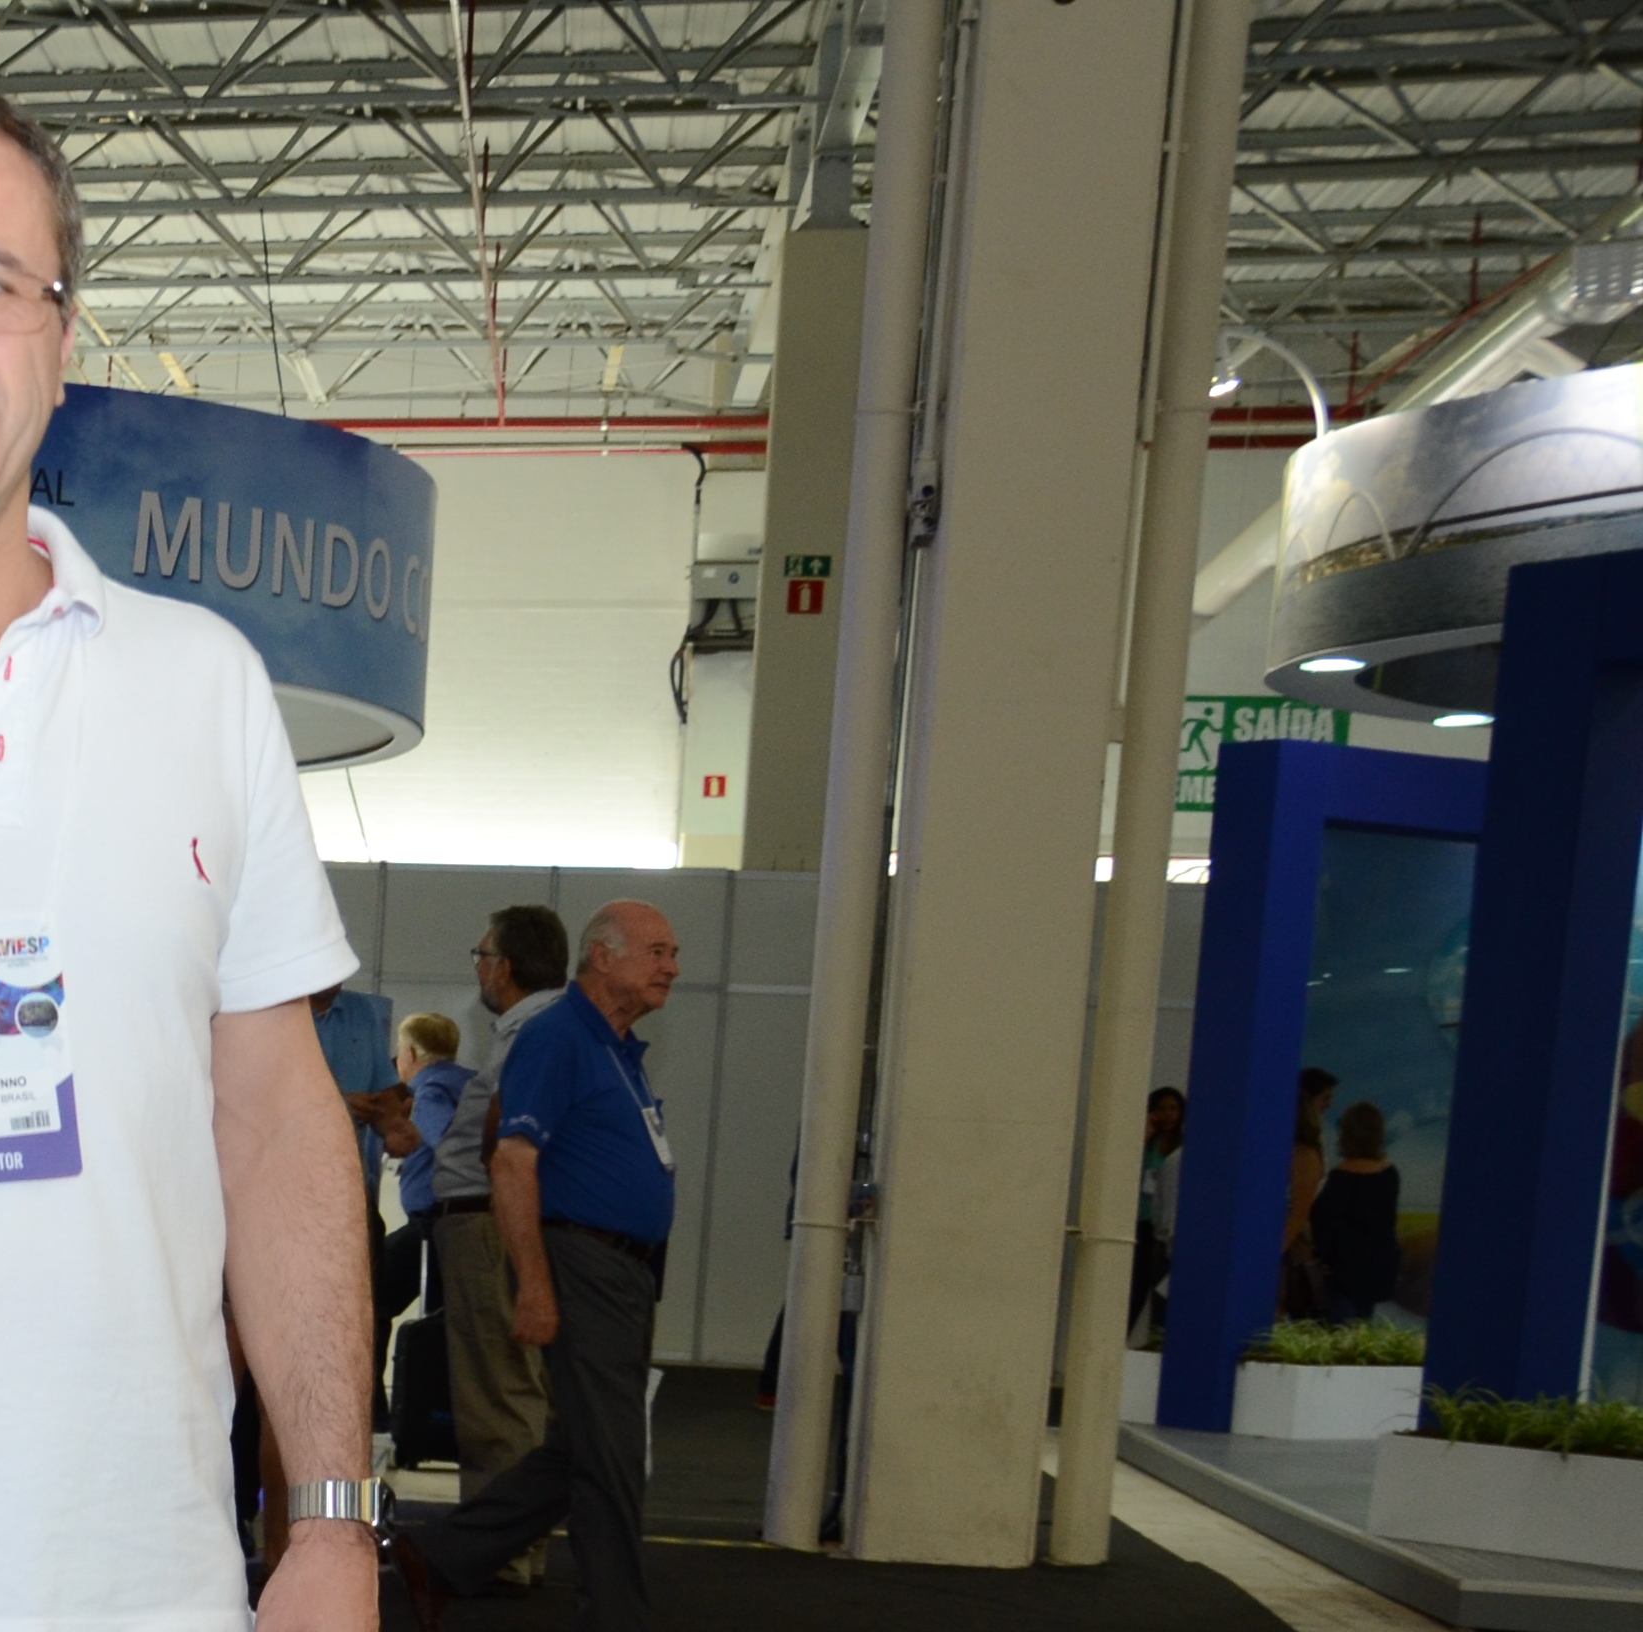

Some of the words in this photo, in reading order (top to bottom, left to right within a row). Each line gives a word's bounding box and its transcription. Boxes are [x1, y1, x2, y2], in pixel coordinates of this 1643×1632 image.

[133, 490, 393, 620] MUNDO
[1232, 702, 1335, 743] SAÍDA
[1, 1091, 36, 1103] BRASIL
